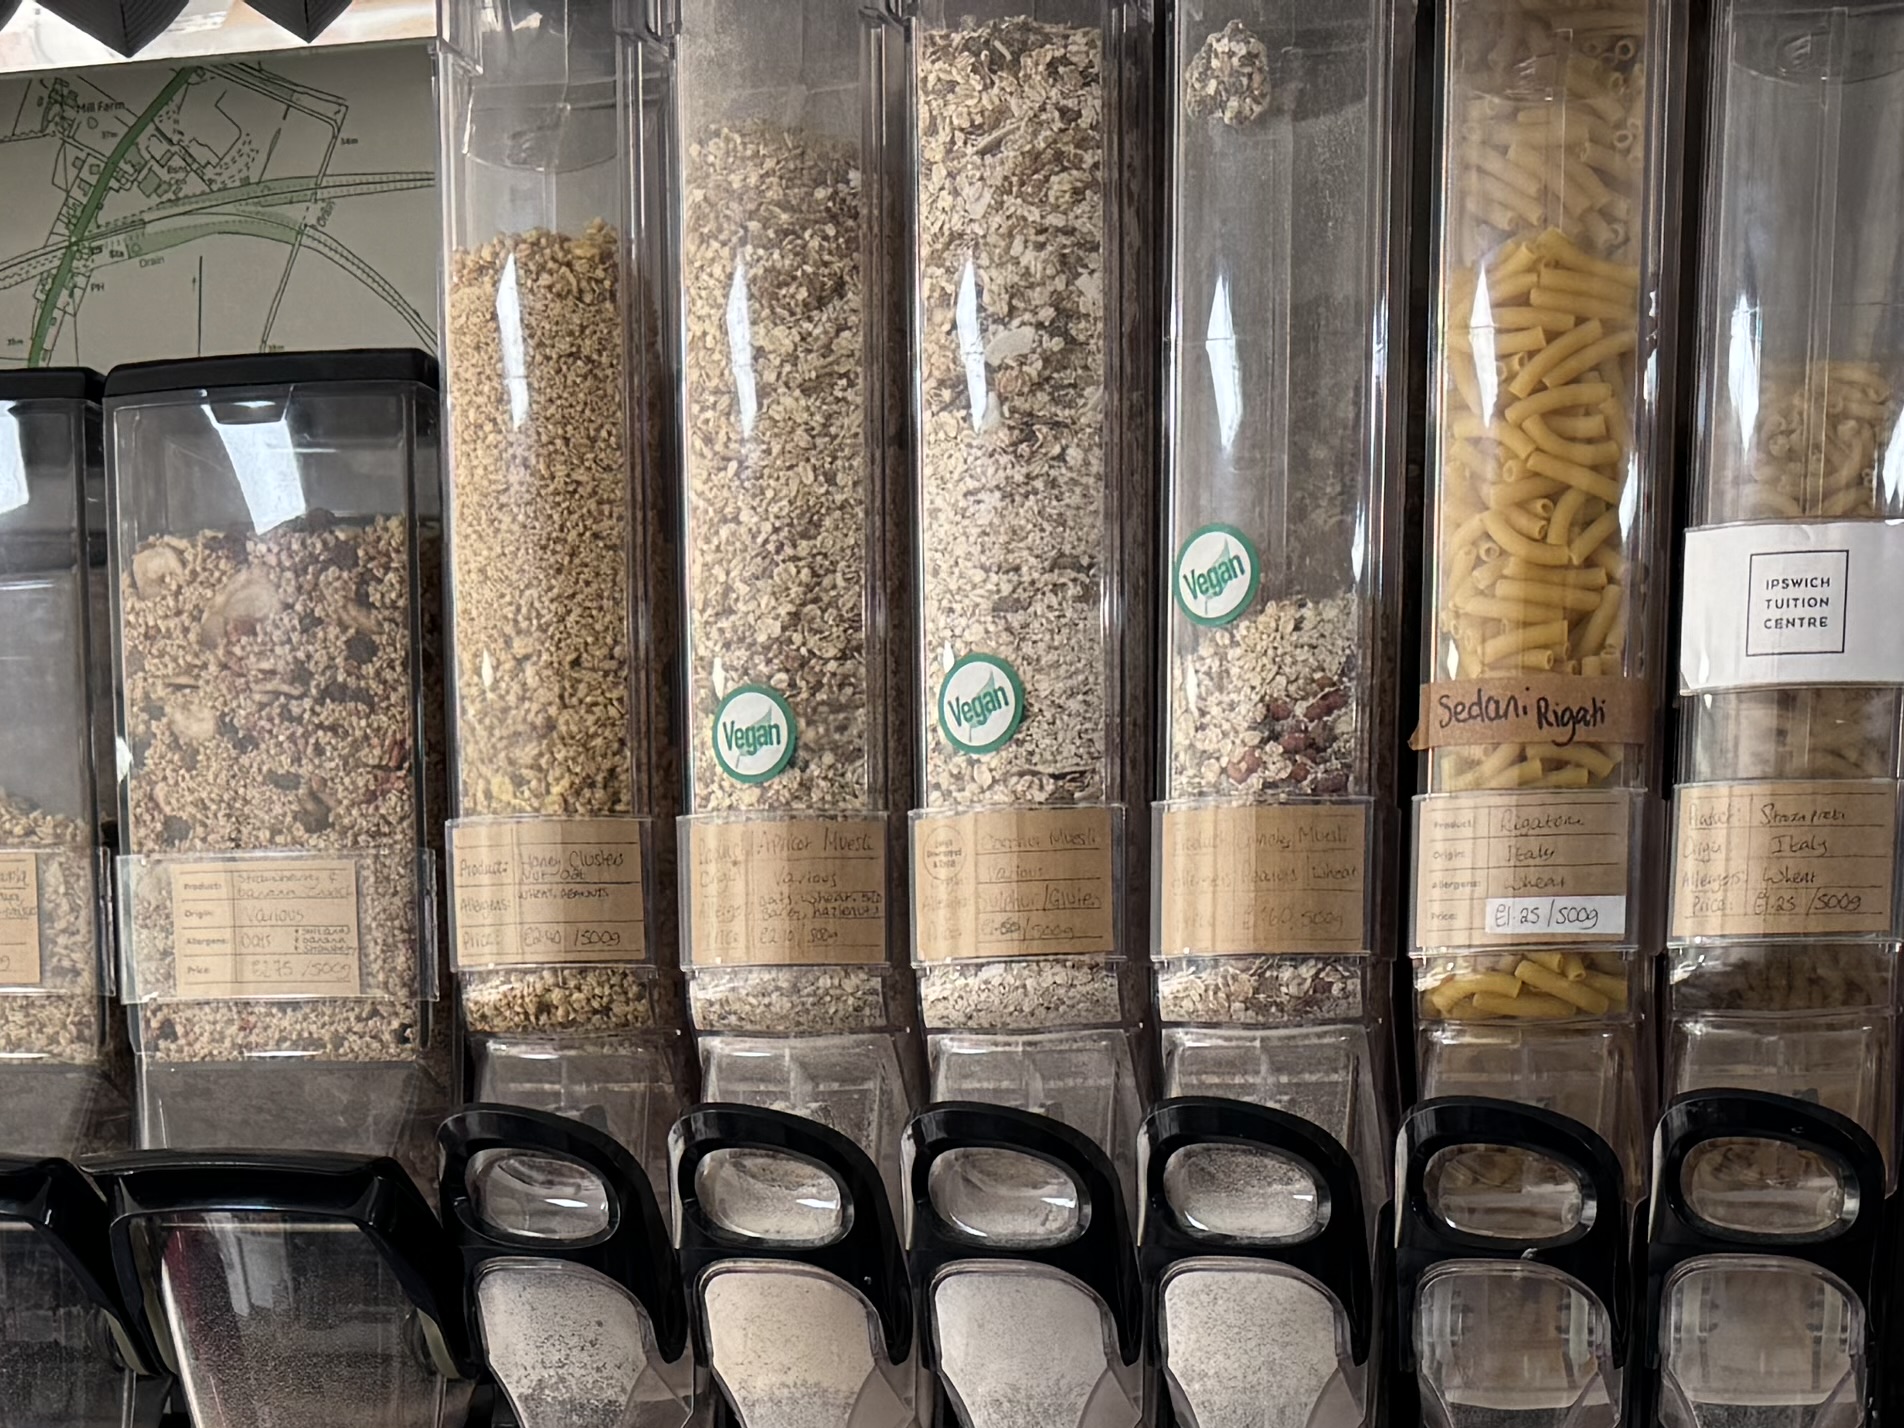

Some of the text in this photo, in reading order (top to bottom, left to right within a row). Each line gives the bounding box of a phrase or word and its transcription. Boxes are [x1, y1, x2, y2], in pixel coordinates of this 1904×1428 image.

[94, 99, 125, 113] Farm
[1182, 556, 1246, 601] Vegan
[1765, 577, 1832, 591] IPSWICH
[1764, 596, 1830, 610] TUITION
[1763, 616, 1829, 630] CENTRE
[948, 686, 1009, 727] Vegan
[1439, 686, 1606, 746] Sedani Rigati
[722, 721, 781, 756] Vegan
